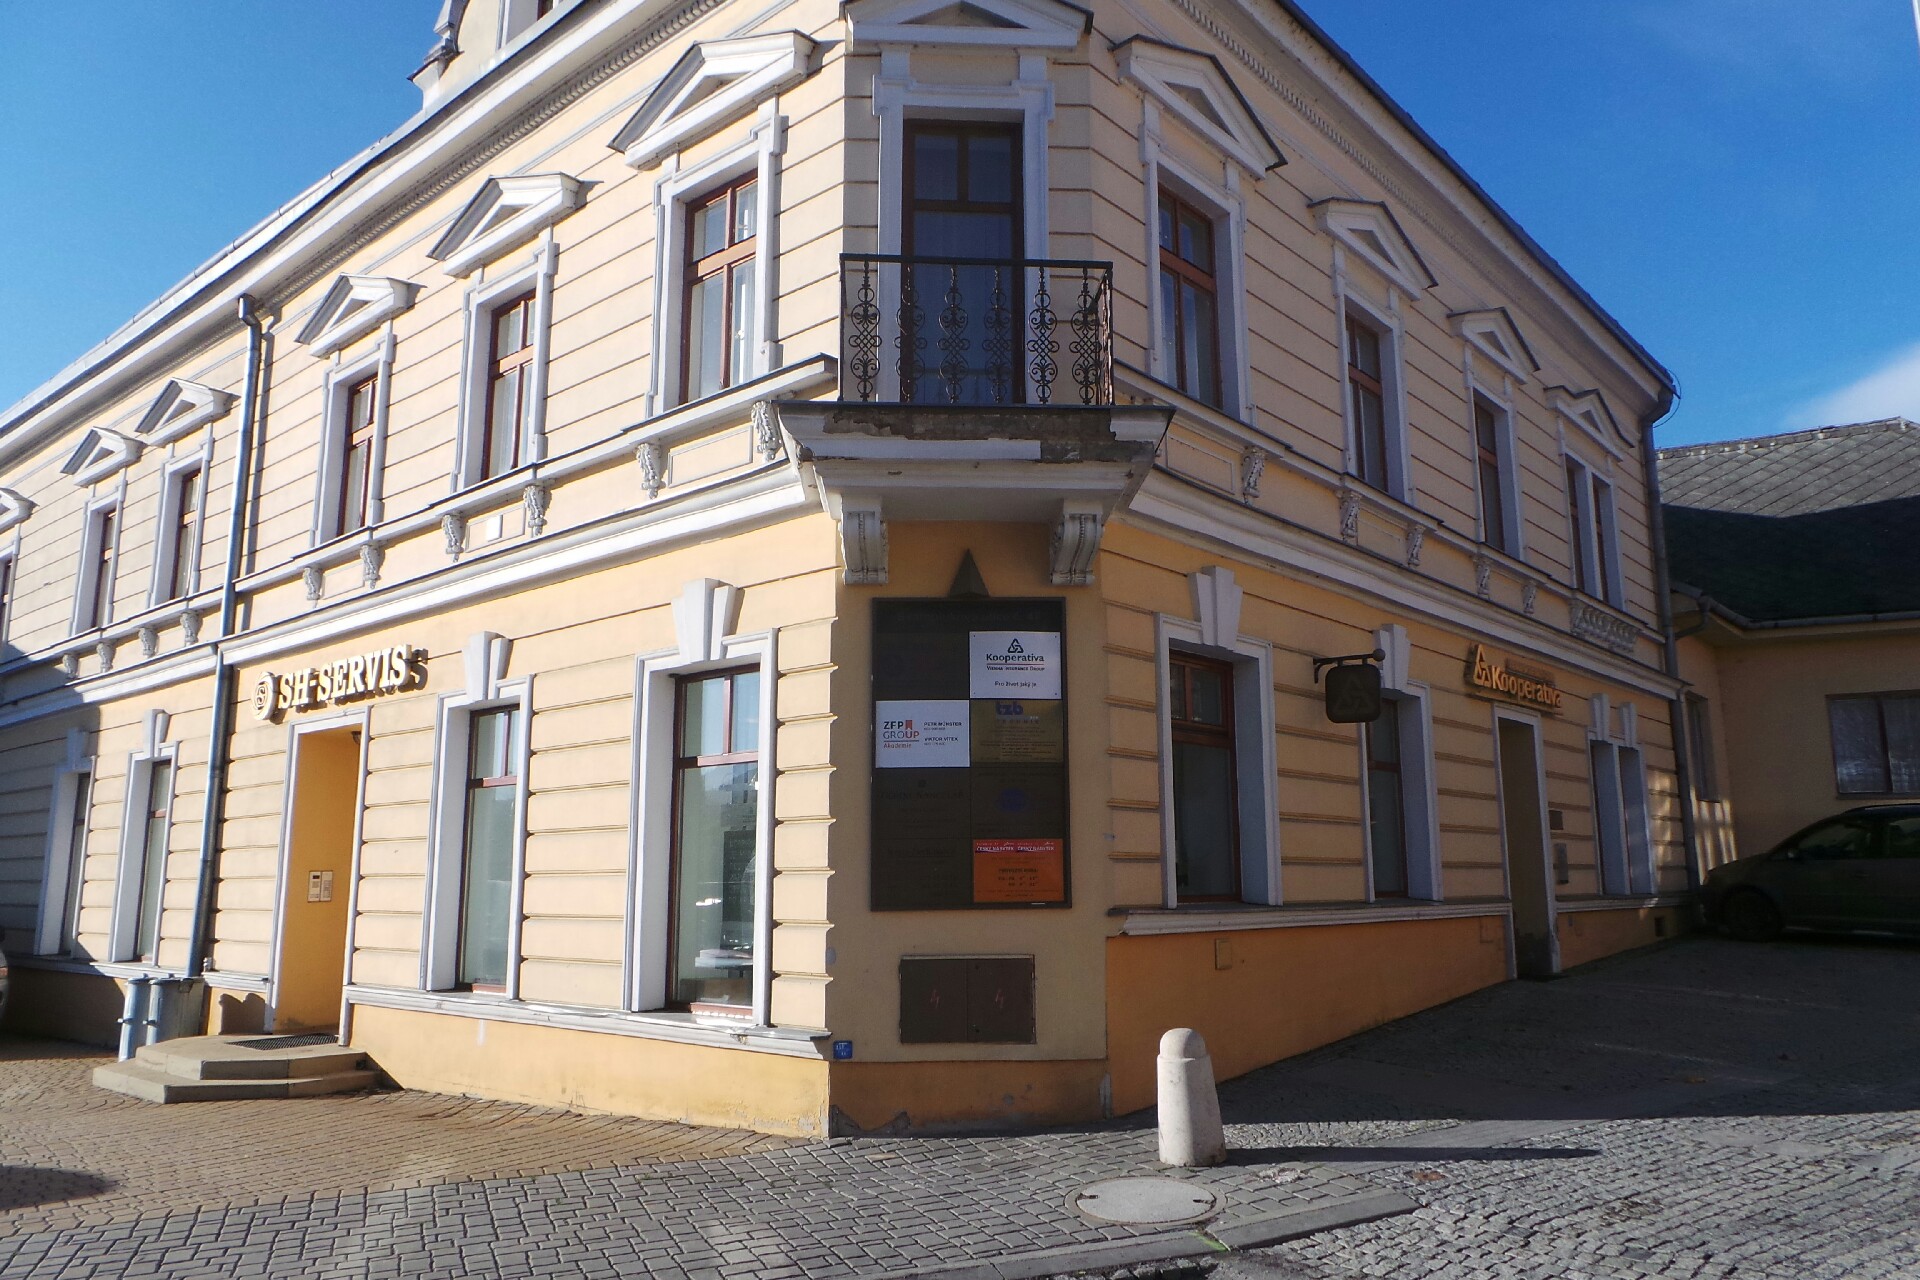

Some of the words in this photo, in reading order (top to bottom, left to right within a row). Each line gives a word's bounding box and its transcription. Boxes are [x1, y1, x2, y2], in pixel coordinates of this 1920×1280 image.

[986, 653, 1045, 664] Kooperativa
[278, 644, 412, 710] SH-SERVIS
[1491, 664, 1562, 709] Kooperativa
[883, 720, 904, 730] ZFP
[882, 730, 920, 739] GROUP
